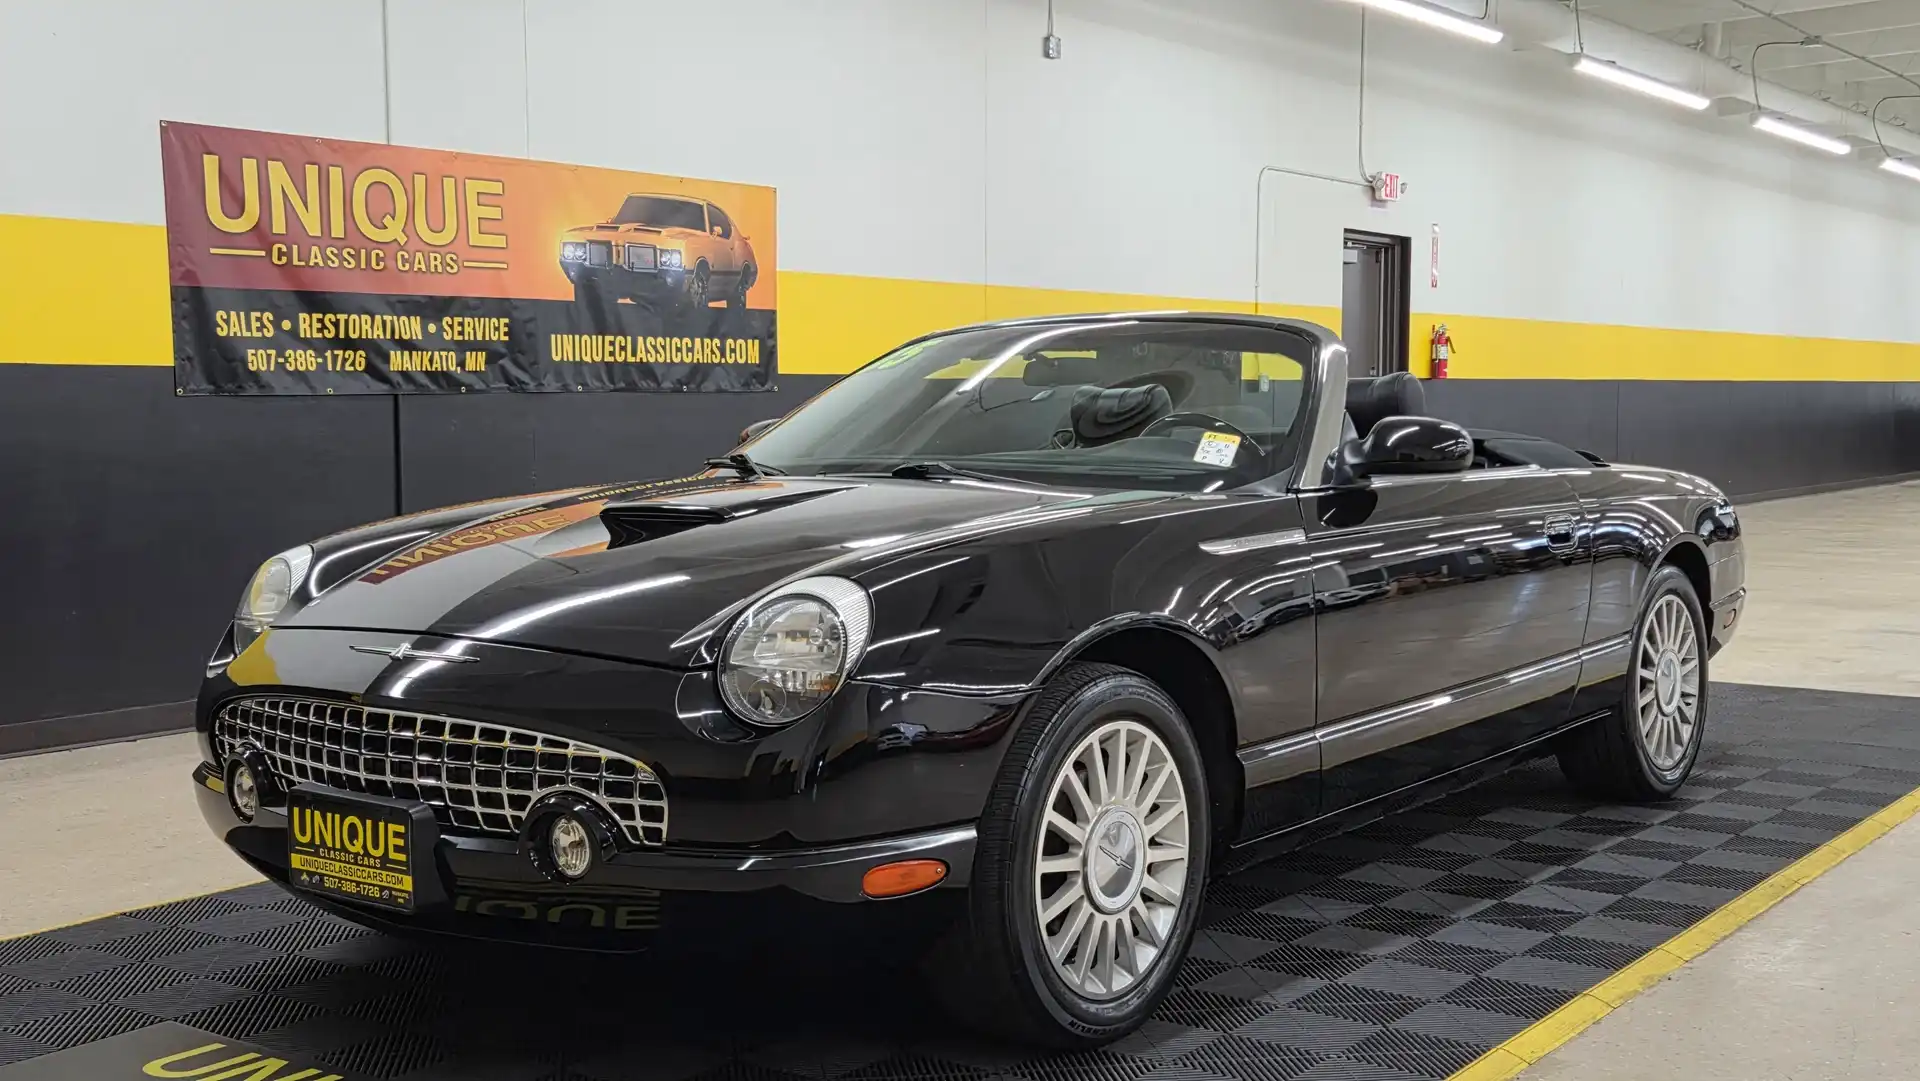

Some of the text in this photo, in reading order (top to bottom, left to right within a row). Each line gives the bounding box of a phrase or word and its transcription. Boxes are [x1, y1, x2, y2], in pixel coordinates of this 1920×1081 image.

[203, 154, 507, 248] UNIQUE
[1384, 173, 1399, 199] EXIT
[271, 243, 460, 274] CLASSIC CARS
[215, 310, 509, 341] SALES RESTORATION SERVICE
[247, 349, 486, 374] 507-386-1726 MANKATO, MN
[550, 334, 760, 364] UNIQUECLASSICCARS.COM
[293, 806, 407, 862] UNIQUE
[300, 857, 404, 887] UNIQUECLASSICCARS.COM
[319, 848, 381, 868] CLASSIC CARS
[324, 876, 380, 898] 507-386-1726
